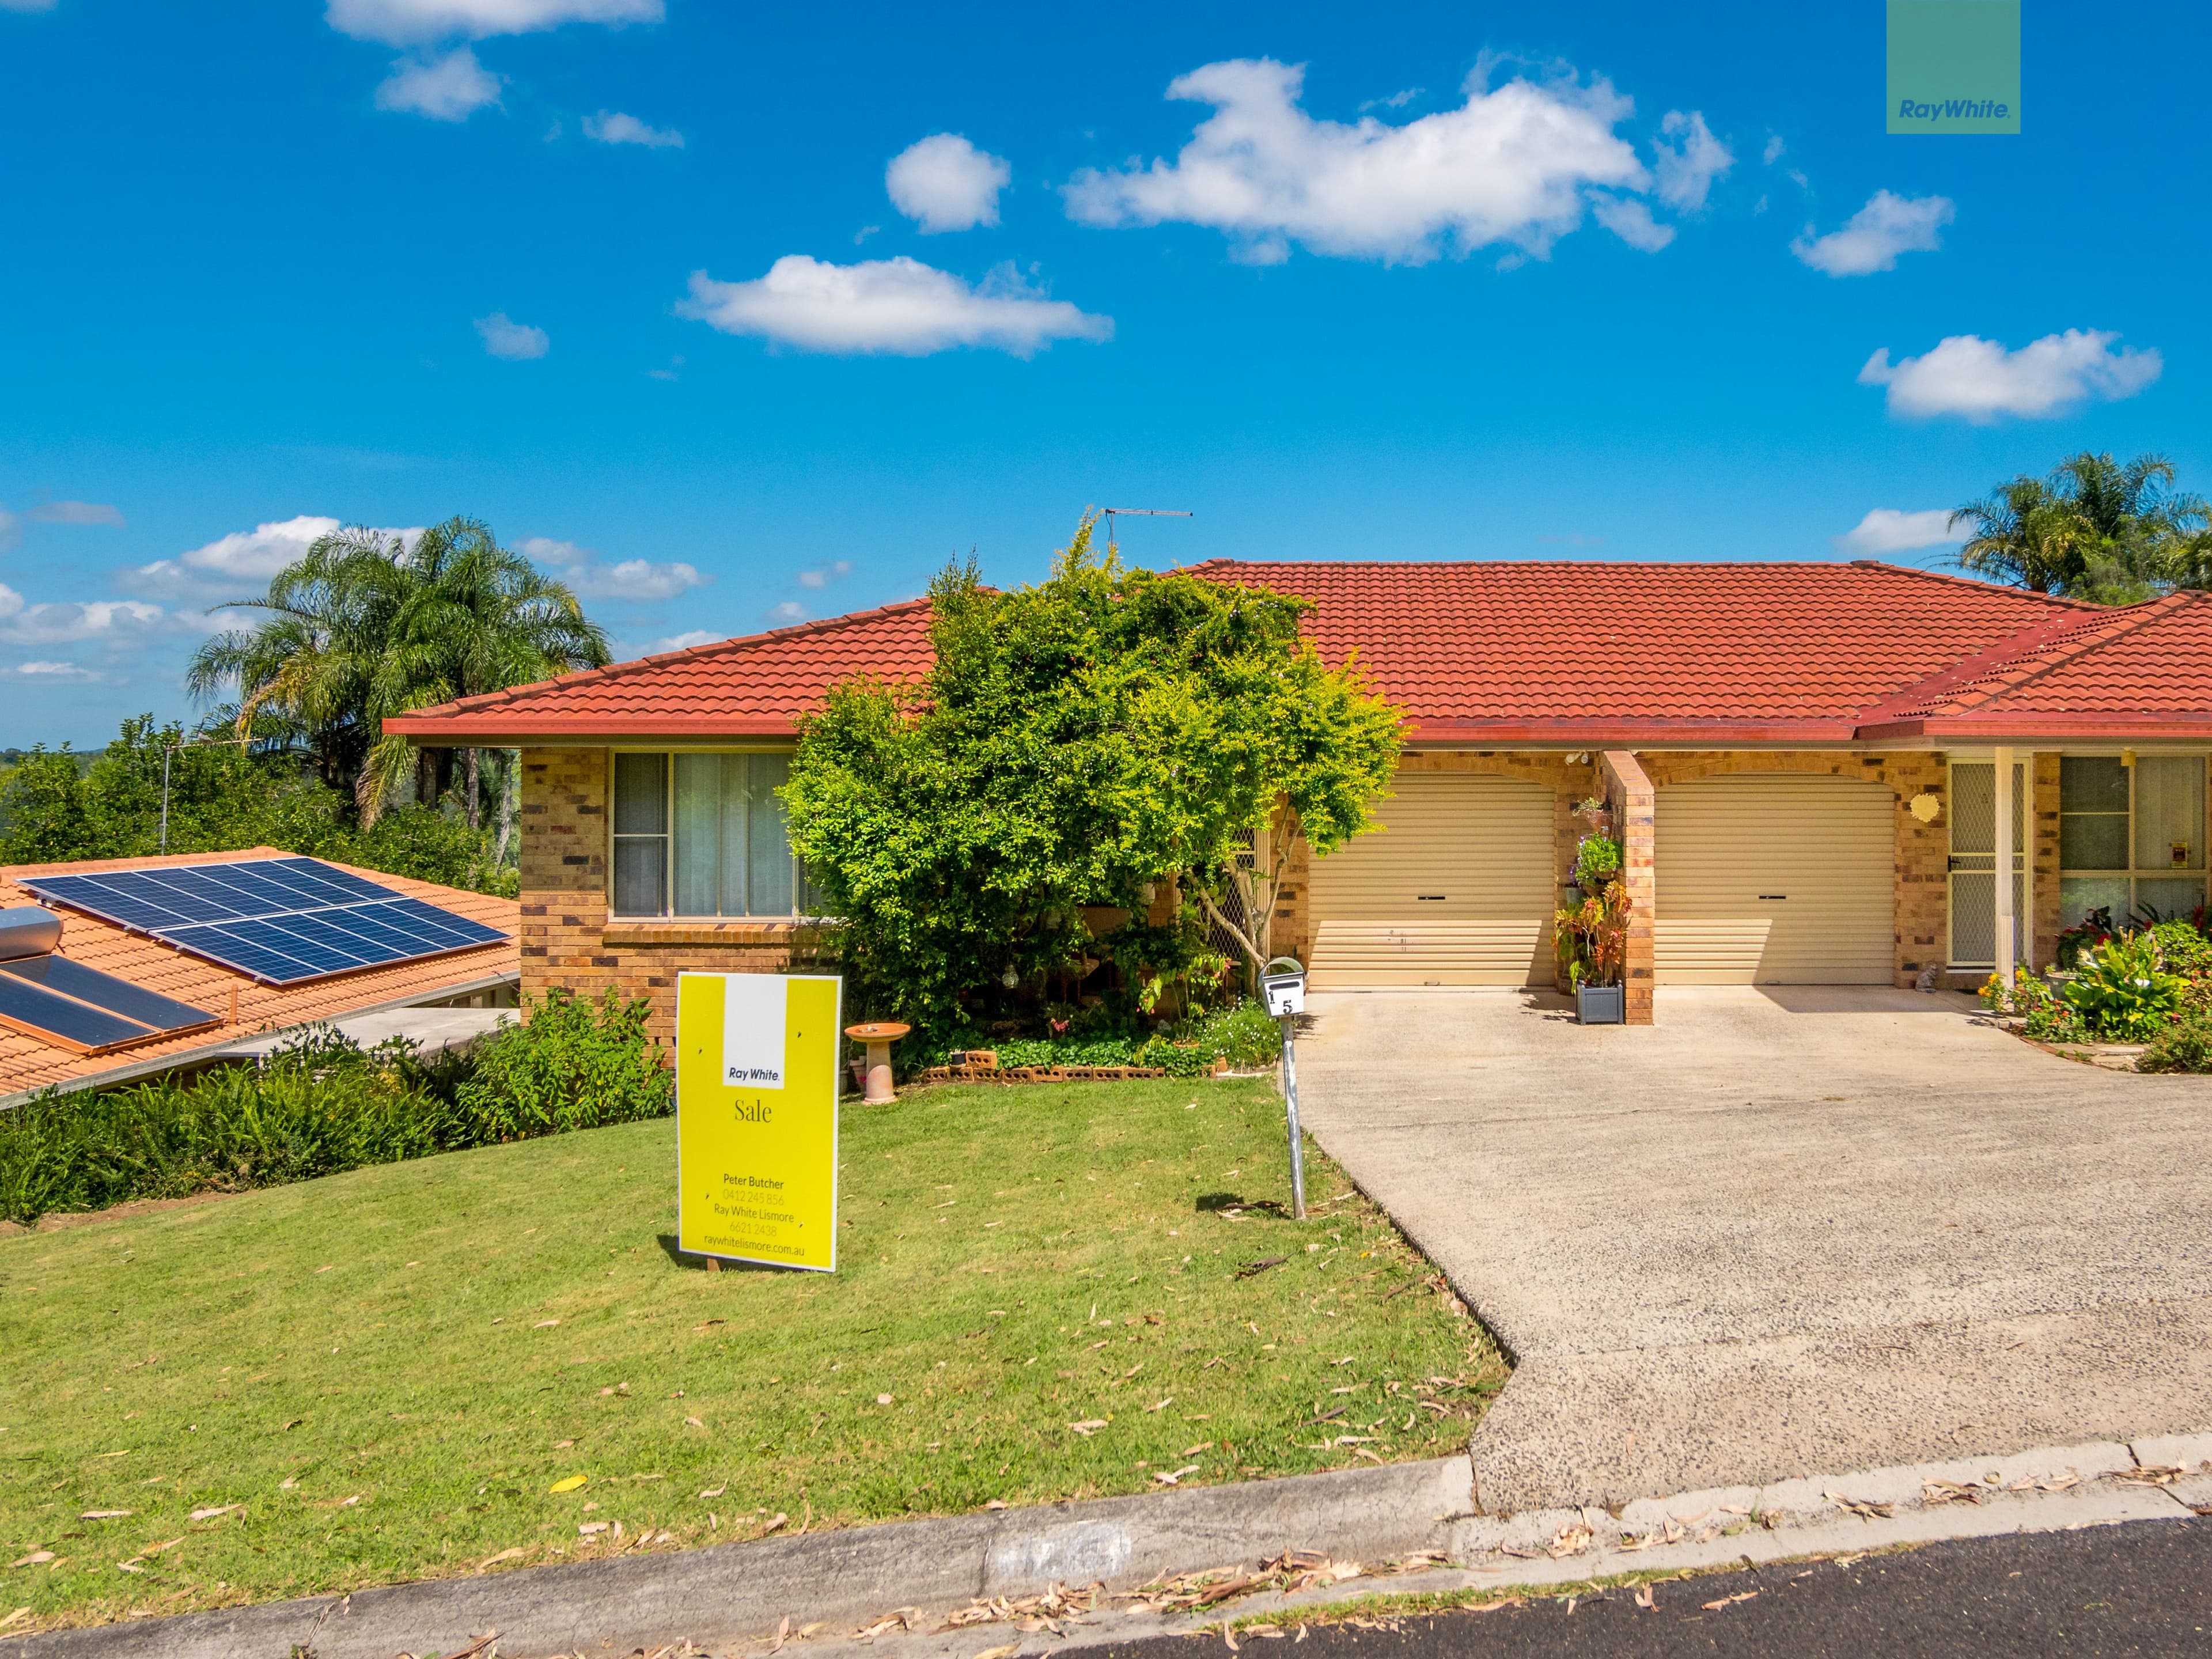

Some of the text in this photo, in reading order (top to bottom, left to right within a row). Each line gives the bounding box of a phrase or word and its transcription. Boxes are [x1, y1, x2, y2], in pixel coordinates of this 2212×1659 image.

[1268, 991, 1275, 1004] 1
[1283, 999, 1293, 1014] 5
[729, 1067, 748, 1081] Ray
[734, 1099, 772, 1123] Sale
[724, 1173, 784, 1190] Peter Butcher
[723, 1188, 784, 1206] 0412 245 856
[714, 1203, 794, 1223] Ray White Lismore
[730, 1221, 777, 1237] 6621 2438
[704, 1235, 805, 1256] raywhitelismore.com.au
